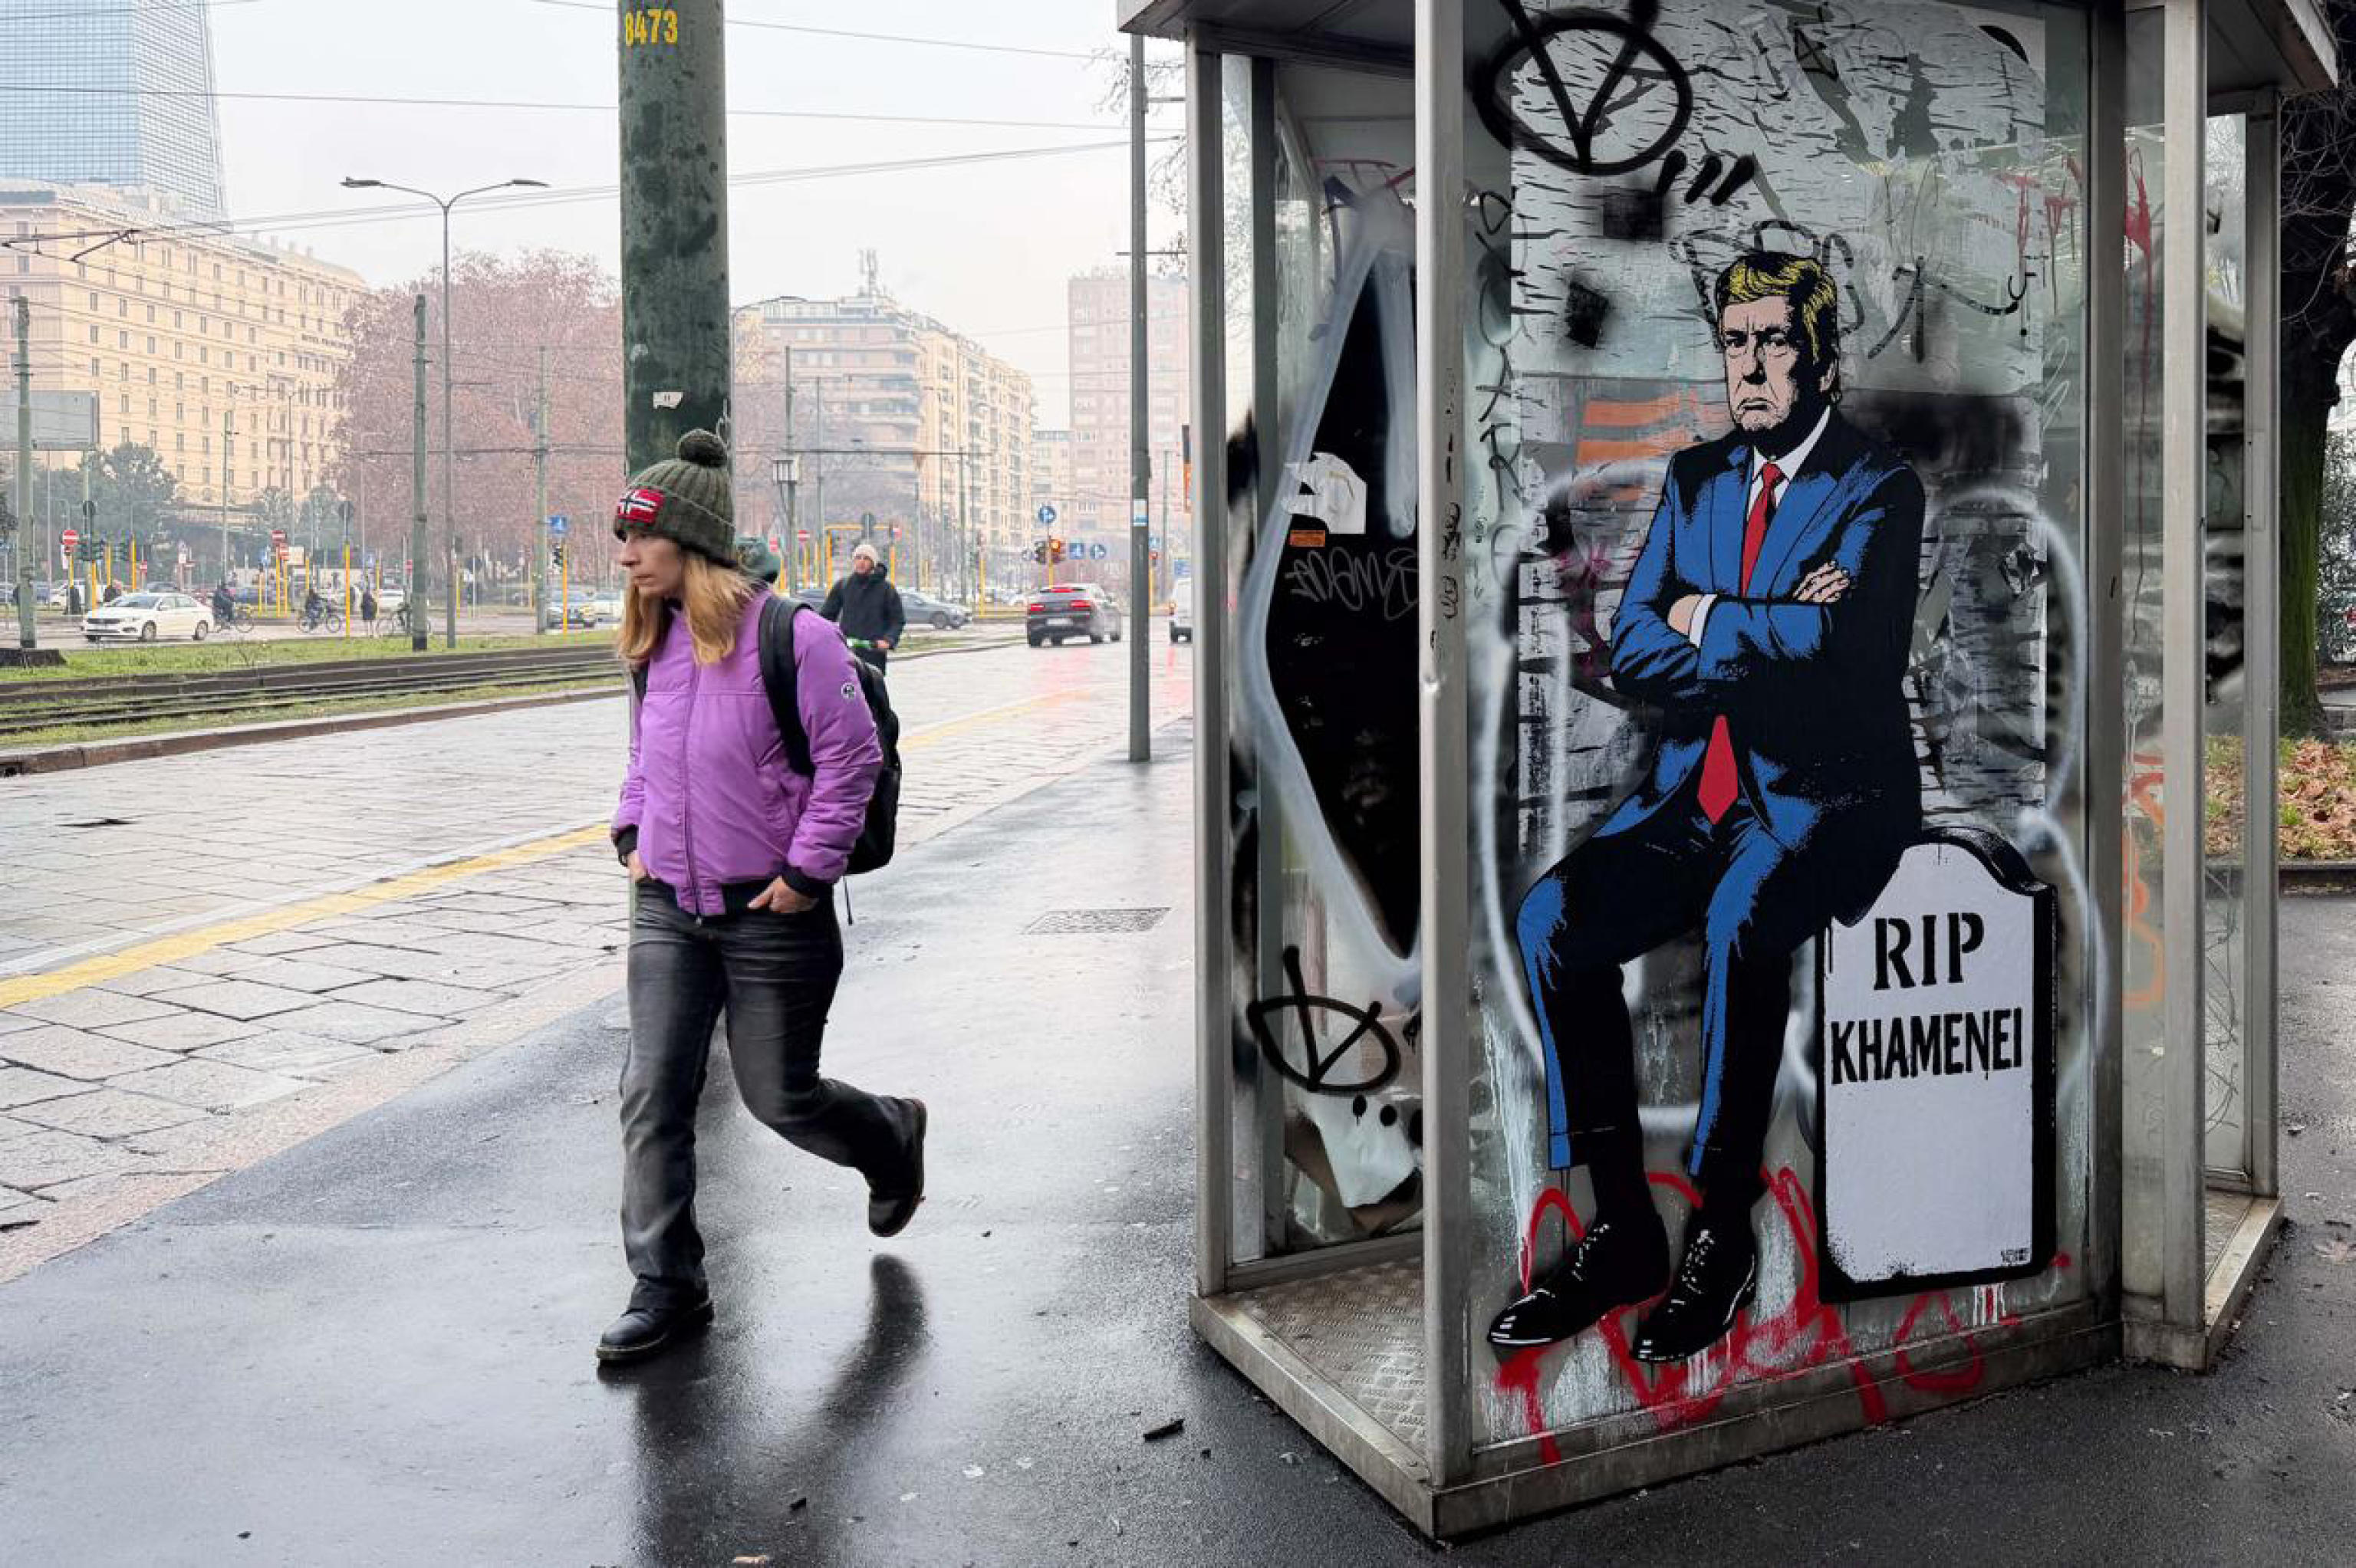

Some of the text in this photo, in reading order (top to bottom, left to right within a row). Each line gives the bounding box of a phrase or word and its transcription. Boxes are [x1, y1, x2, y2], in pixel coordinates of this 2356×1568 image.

[625, 9, 678, 46] 8473
[1874, 912, 1985, 991] RIP
[1831, 1007, 2023, 1086] KHAMENEI
